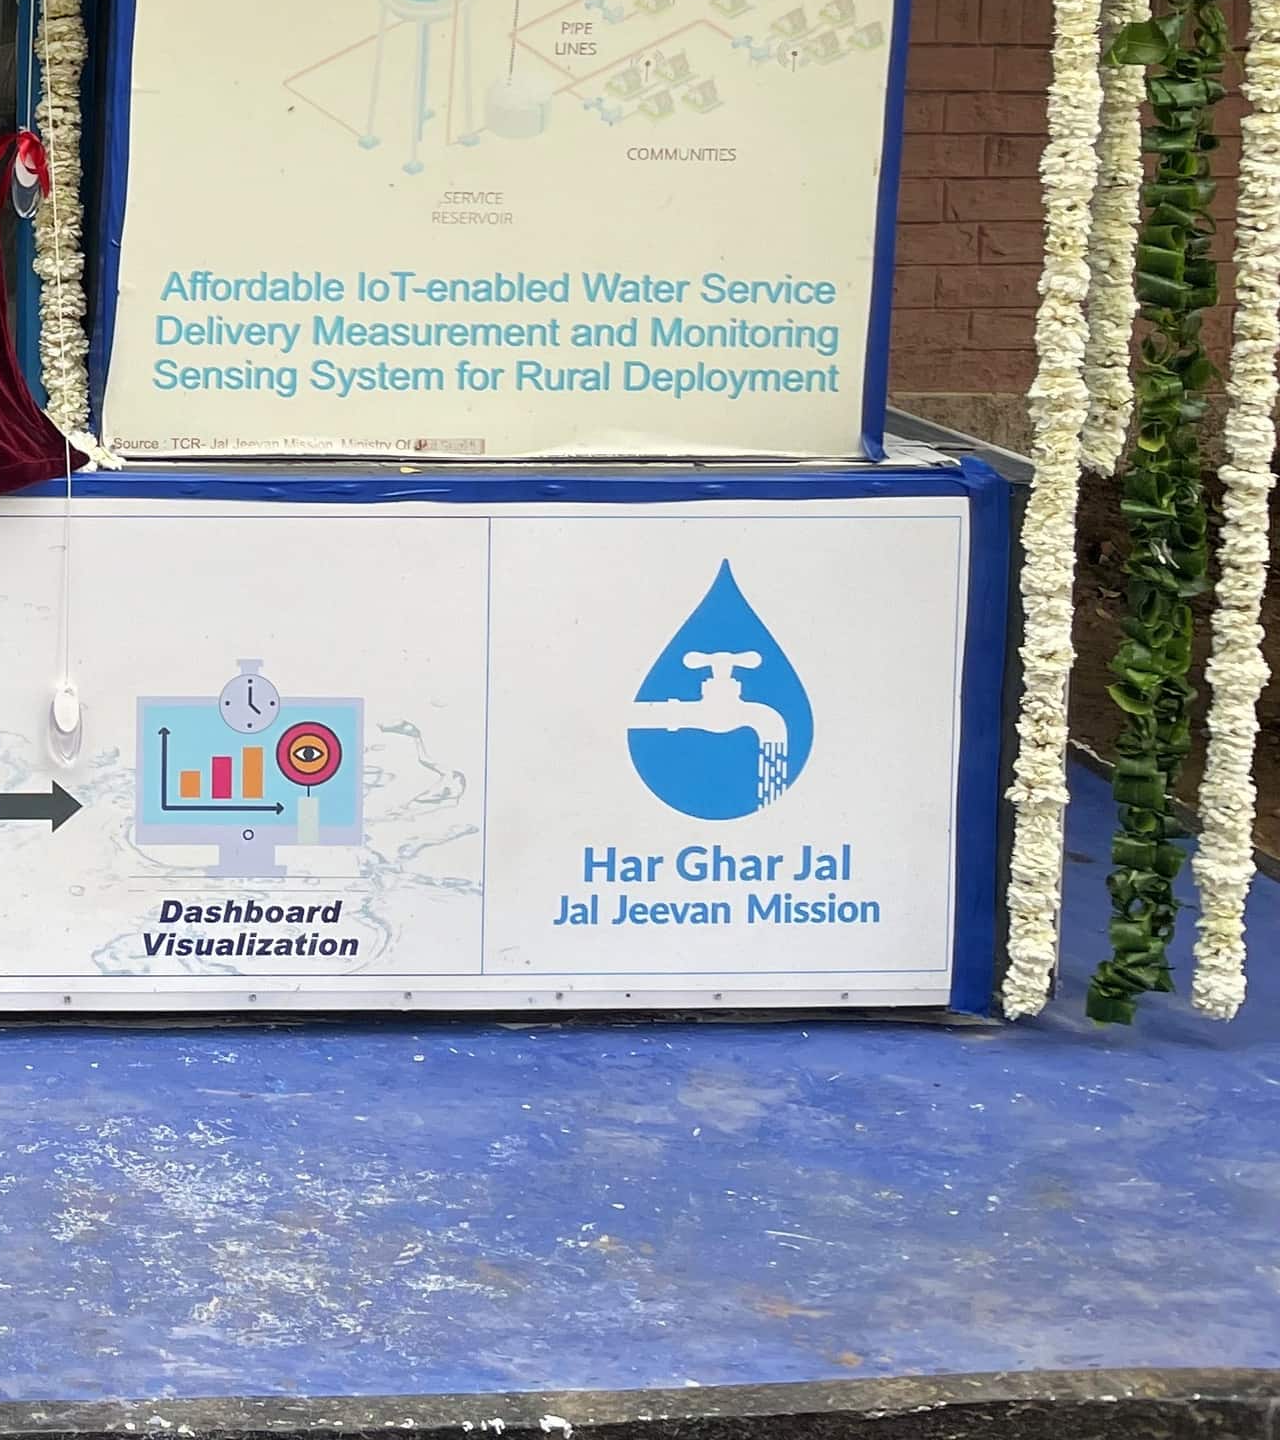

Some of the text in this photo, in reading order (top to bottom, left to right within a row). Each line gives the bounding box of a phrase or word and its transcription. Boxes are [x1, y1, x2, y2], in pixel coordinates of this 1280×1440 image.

[562, 22, 592, 34] PIPE
[555, 42, 597, 55] LINES
[627, 148, 736, 161] COMMUNITIES
[443, 191, 503, 206] SERVICE
[432, 211, 512, 224] RESERVOIR
[160, 271, 836, 304] Affordable IoT-enabled Water Service
[157, 315, 838, 356] Delivery Measurement and Monitoring
[153, 360, 840, 399] Sensing System for Rural Deployment
[112, 437, 160, 450] Source
[584, 844, 850, 882] Har Ghar Jal
[159, 900, 342, 923] Dashboard
[554, 893, 879, 925] Jal Jeevan Mission
[144, 933, 358, 956] Visualization
